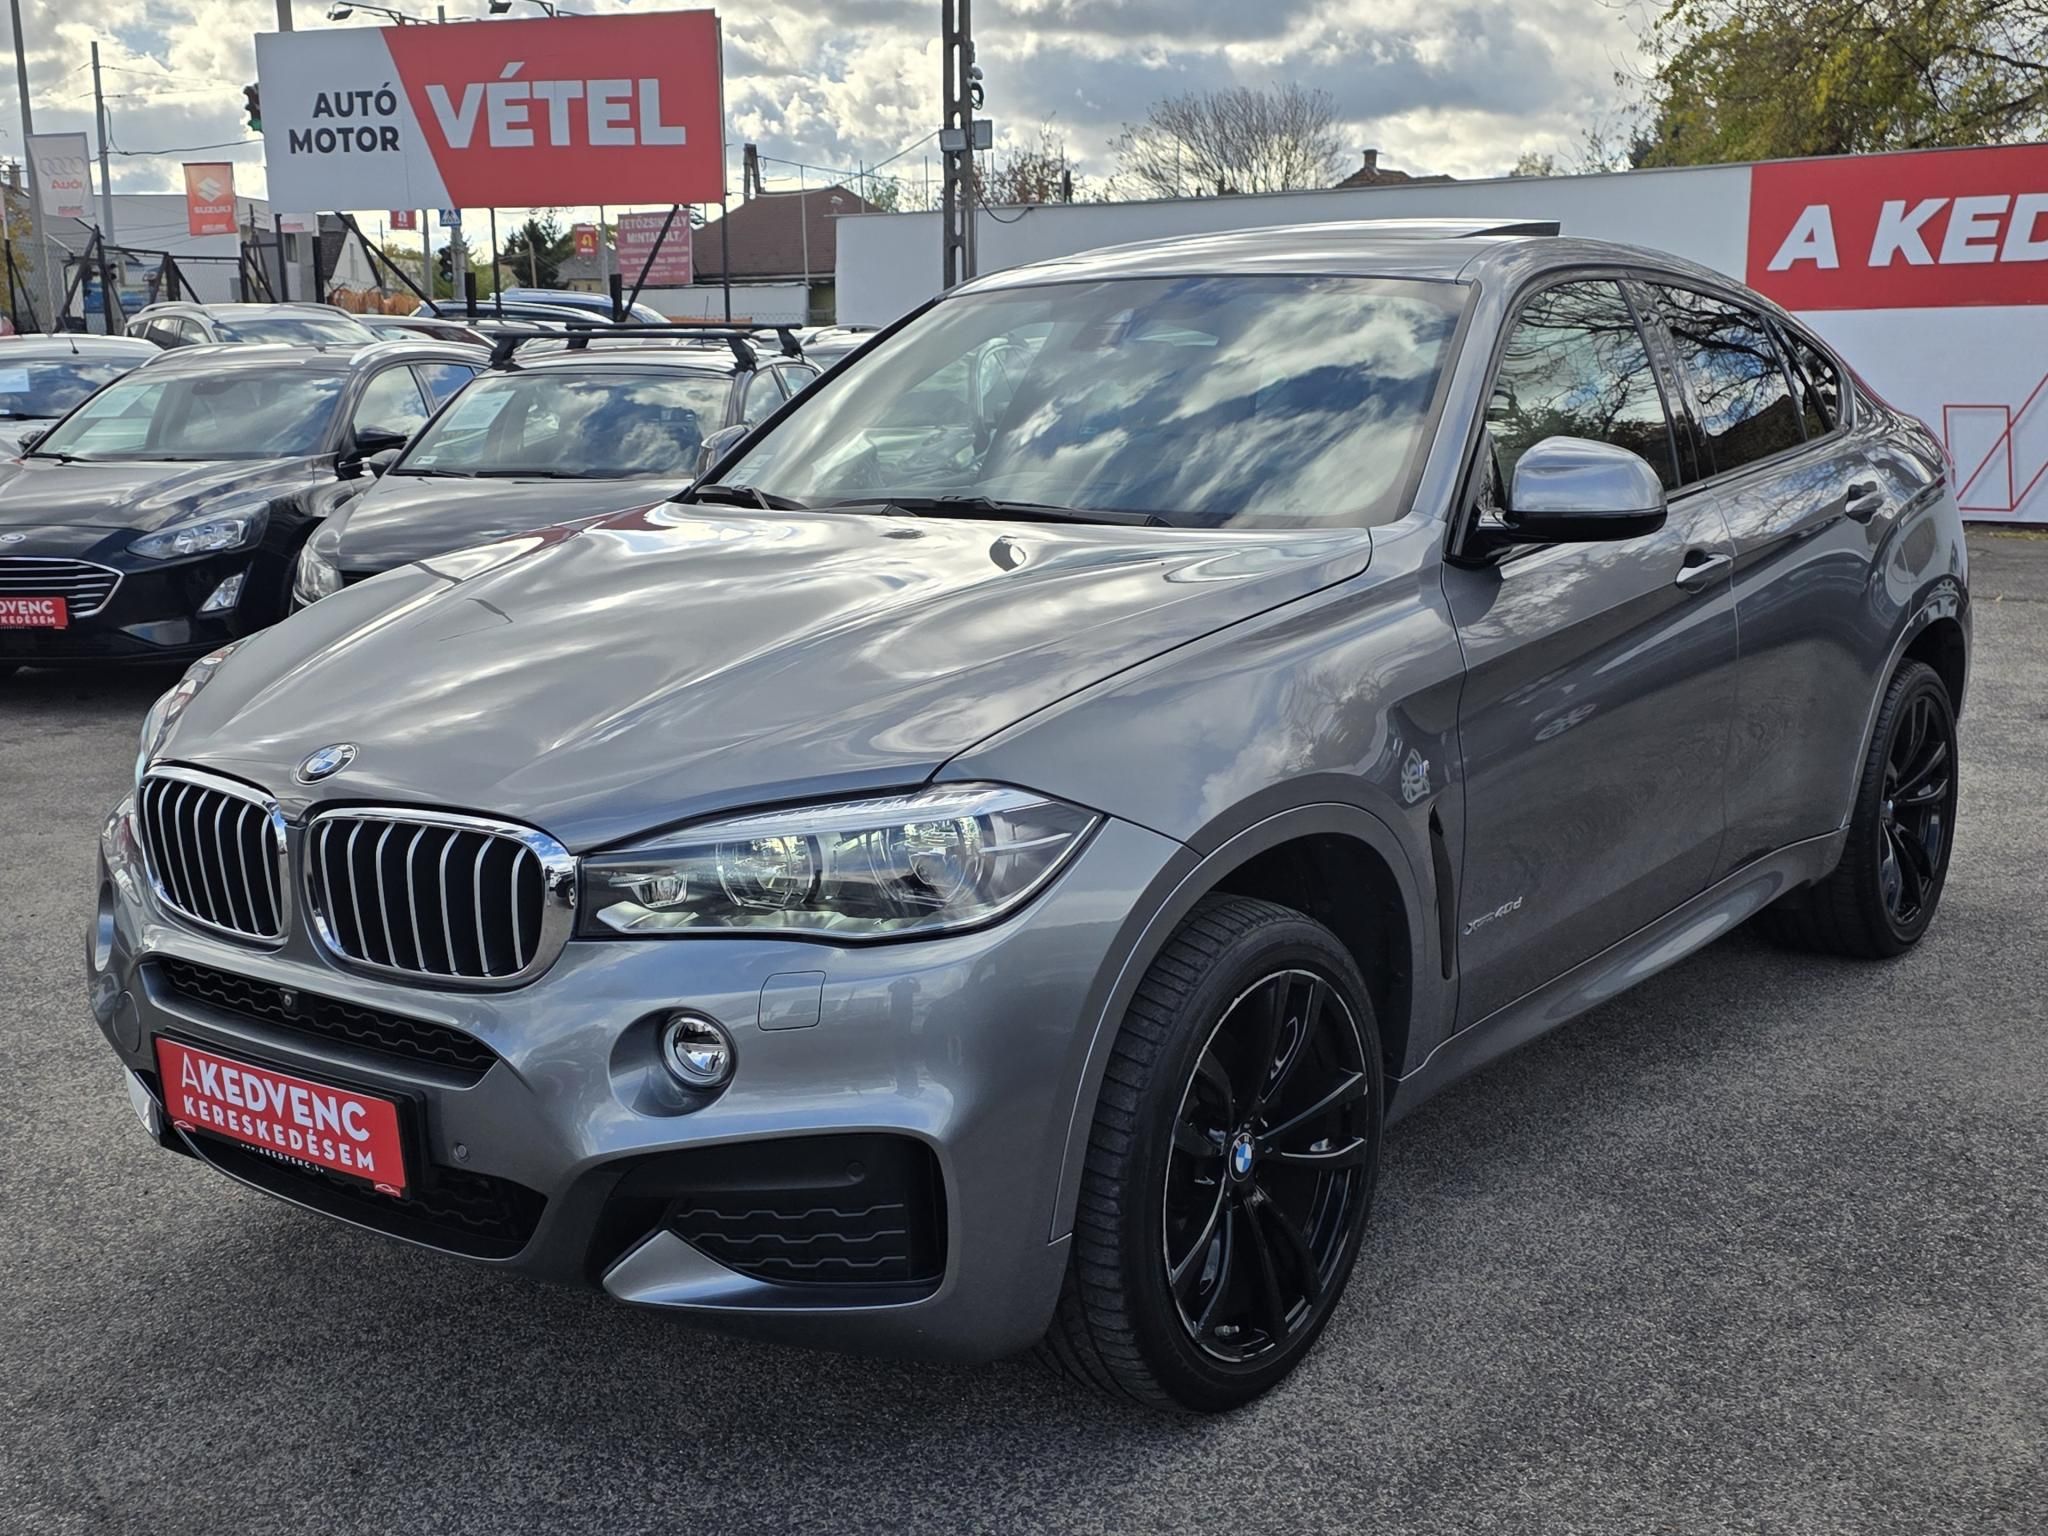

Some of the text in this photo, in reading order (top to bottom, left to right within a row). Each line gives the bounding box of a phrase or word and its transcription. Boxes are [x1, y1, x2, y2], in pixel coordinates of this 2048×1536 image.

[312, 82, 398, 119] AUTÓ
[425, 62, 686, 149] VÉTEL
[288, 126, 400, 154] MOTOR
[1766, 193, 2048, 271] A KED
[183, 1095, 375, 1172] KERESKEDÉSEM
